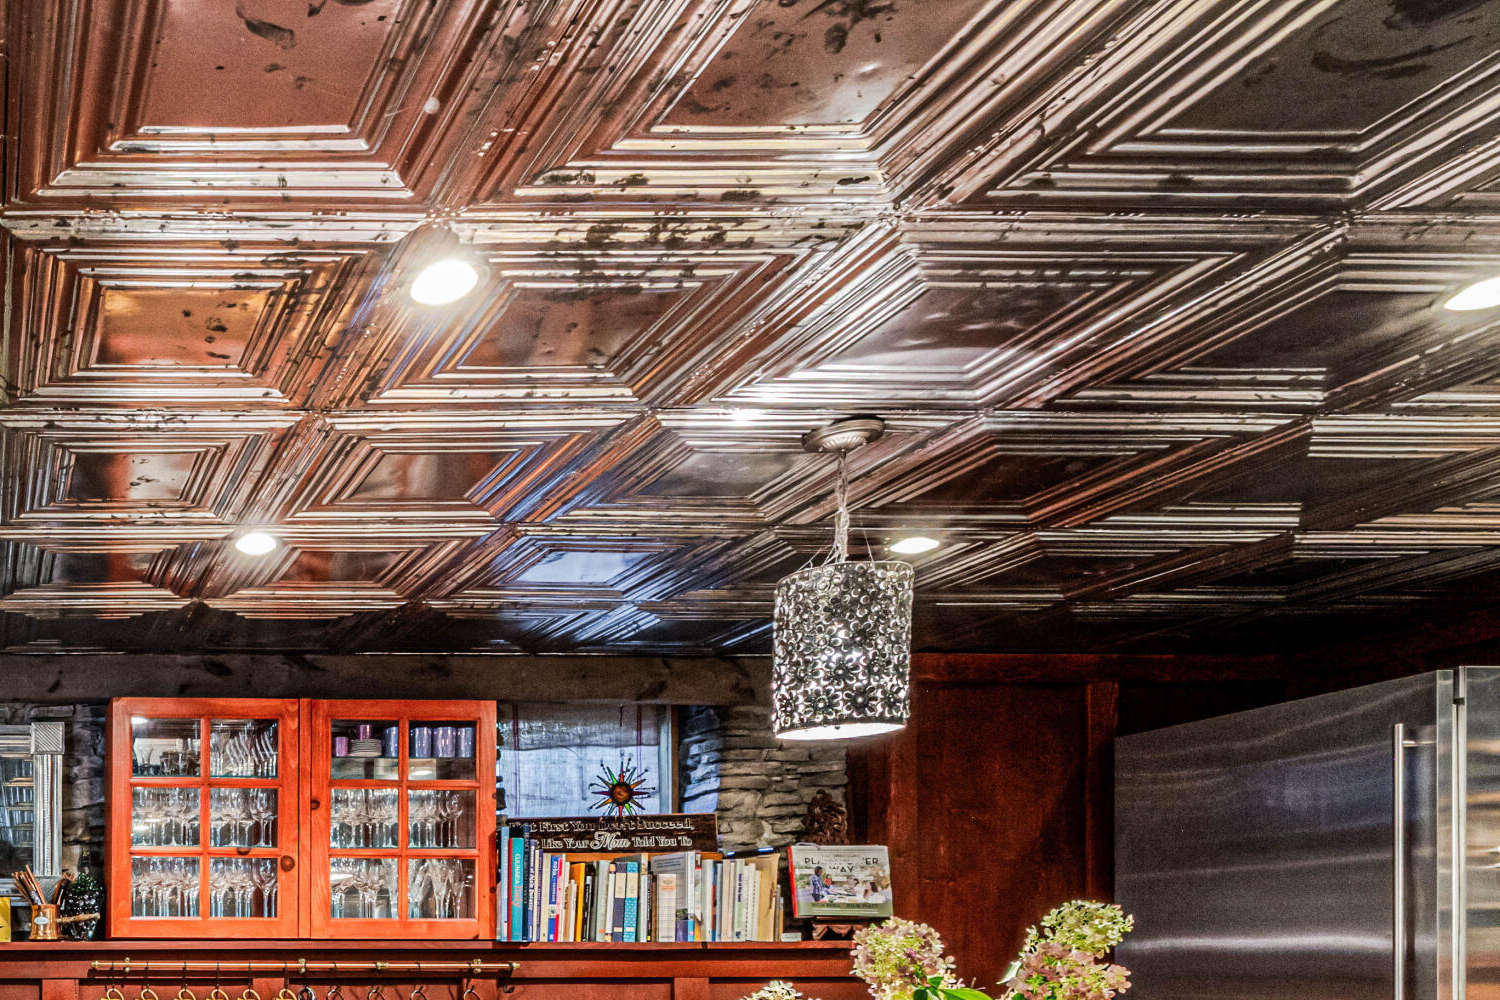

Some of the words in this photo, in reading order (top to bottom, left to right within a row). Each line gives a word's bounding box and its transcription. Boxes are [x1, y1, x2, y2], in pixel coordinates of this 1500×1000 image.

[539, 821, 569, 832] First
[569, 821, 595, 832] You
[636, 817, 695, 831] Succeed,
[541, 838, 563, 849] Like
[563, 838, 589, 849] Your
[590, 831, 631, 850] Mom
[632, 836, 655, 847] Told
[655, 835, 677, 847] You
[678, 835, 693, 846] To
[512, 885, 523, 908] Italy
